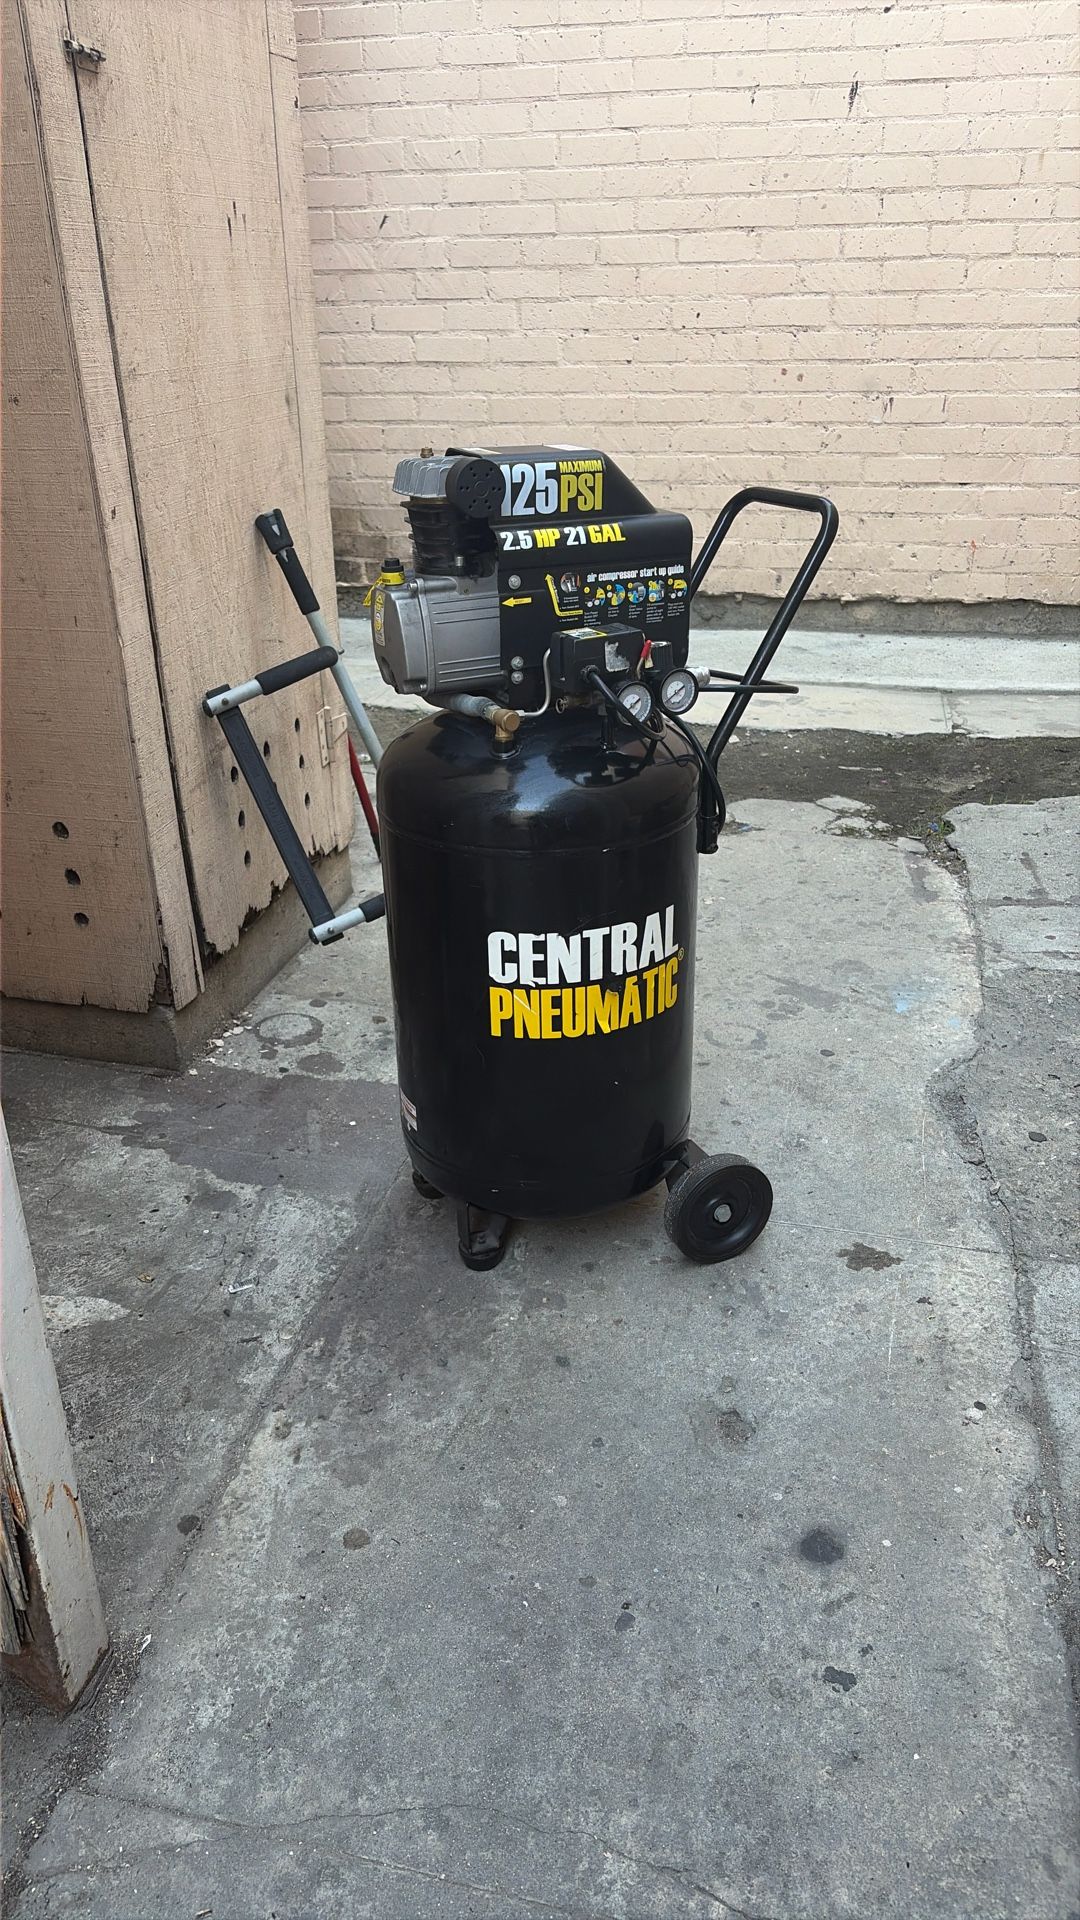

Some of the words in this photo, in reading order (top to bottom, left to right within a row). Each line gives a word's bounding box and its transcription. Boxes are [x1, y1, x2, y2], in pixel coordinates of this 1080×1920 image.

[559, 460, 603, 473] MAXIMUM
[500, 462, 558, 516] 125
[560, 473, 603, 512] PSI
[501, 530, 533, 550] 2.5
[534, 528, 560, 548] HP
[564, 526, 587, 545] 21
[588, 523, 625, 543] GAL
[587, 574, 597, 582] air
[598, 569, 638, 581] compressor
[640, 567, 657, 577] start
[658, 567, 666, 576] up
[667, 564, 685, 575] guide
[487, 904, 679, 986] CENTRAL
[489, 957, 679, 1039] PNEUMATIC
